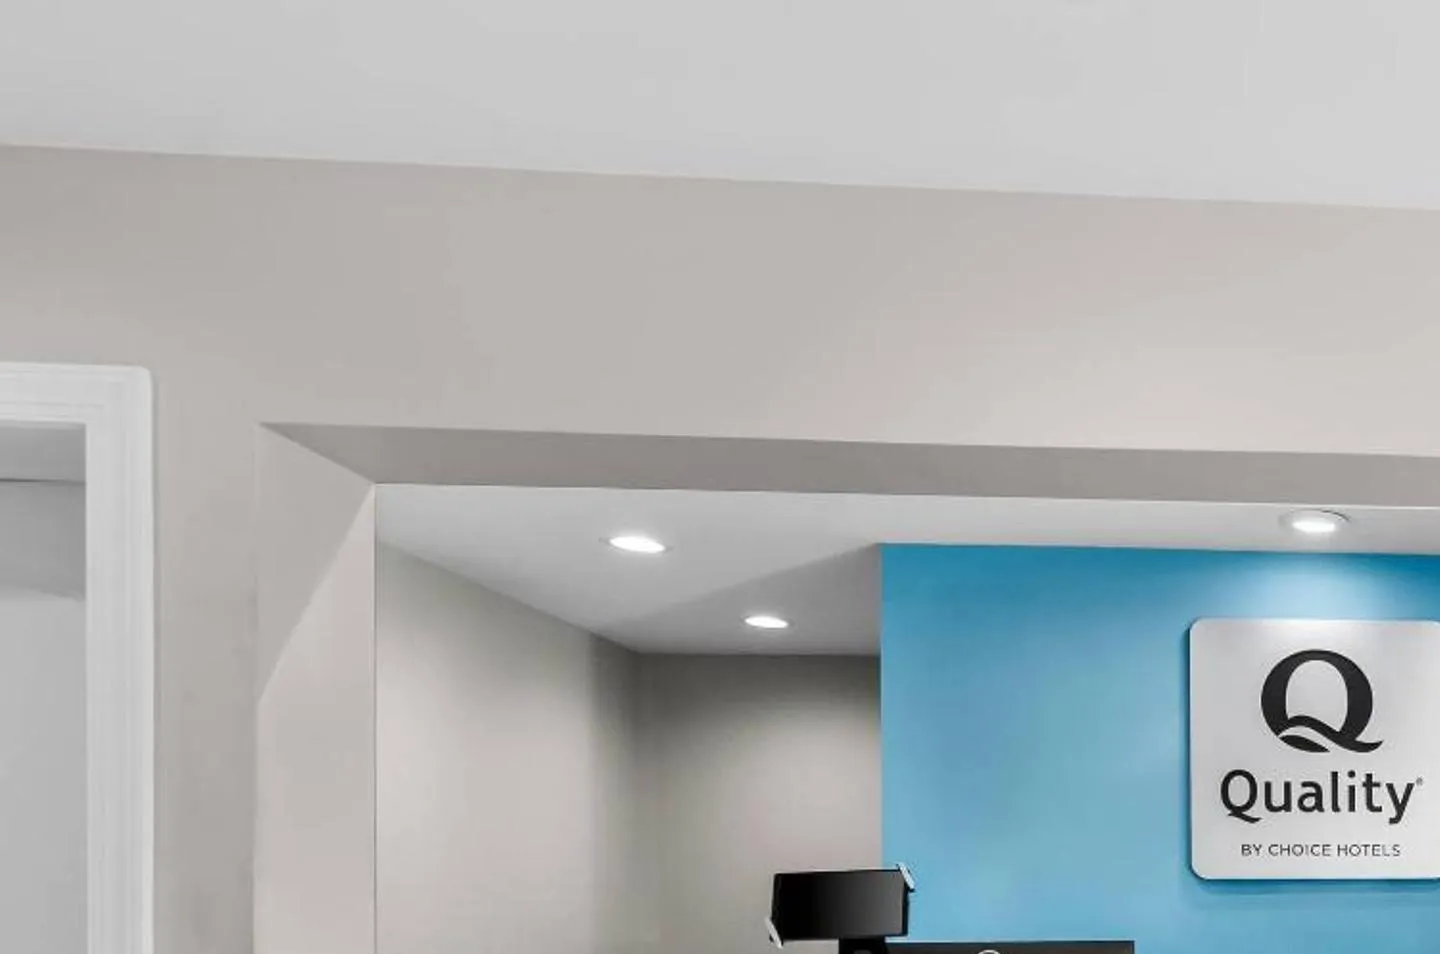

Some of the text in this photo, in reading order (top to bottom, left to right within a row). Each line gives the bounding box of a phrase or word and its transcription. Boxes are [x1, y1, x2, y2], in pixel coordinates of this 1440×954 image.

[1260, 649, 1384, 753] Q
[1220, 768, 1416, 825] Quality
[1240, 843, 1401, 857] BY CHOICE HOTELS
